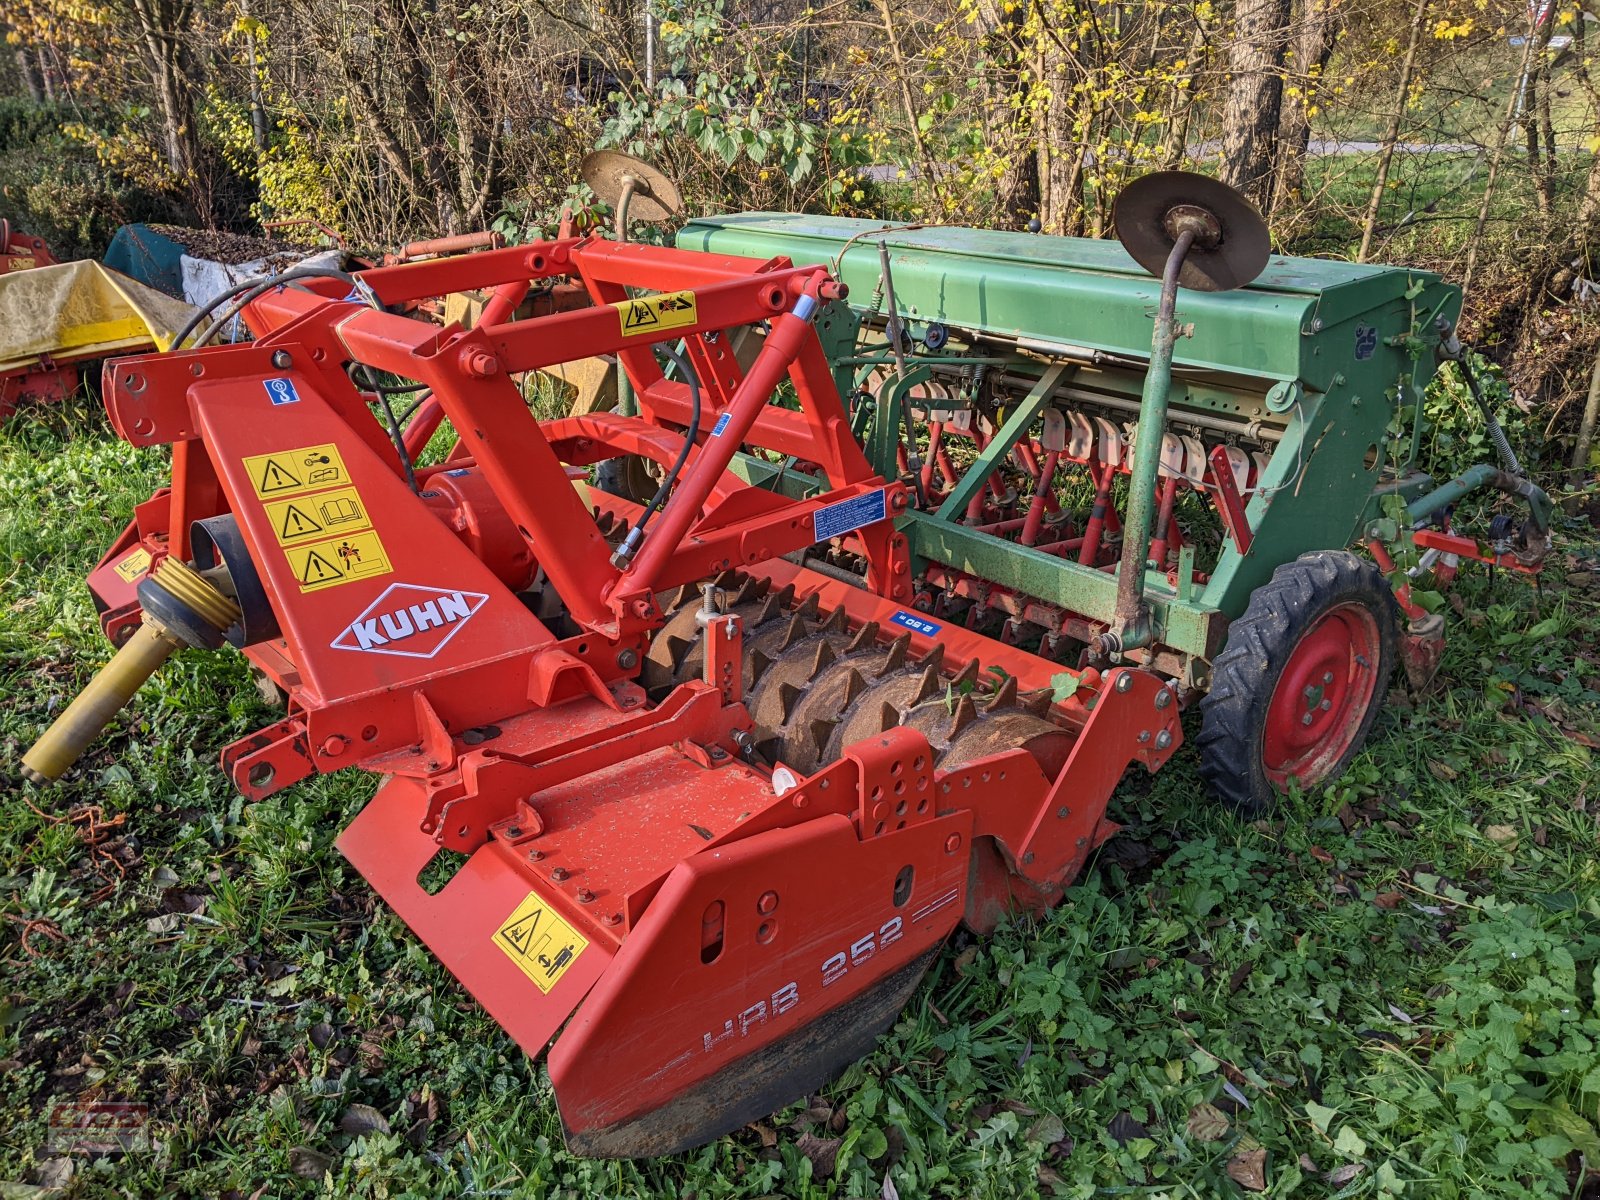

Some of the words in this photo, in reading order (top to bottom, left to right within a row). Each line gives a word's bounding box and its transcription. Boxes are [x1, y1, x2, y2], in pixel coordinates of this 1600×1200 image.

[351, 592, 472, 650] KUHN
[905, 618, 934, 633] 2.50
[703, 981, 799, 1052] HRB
[821, 916, 904, 988] 252
